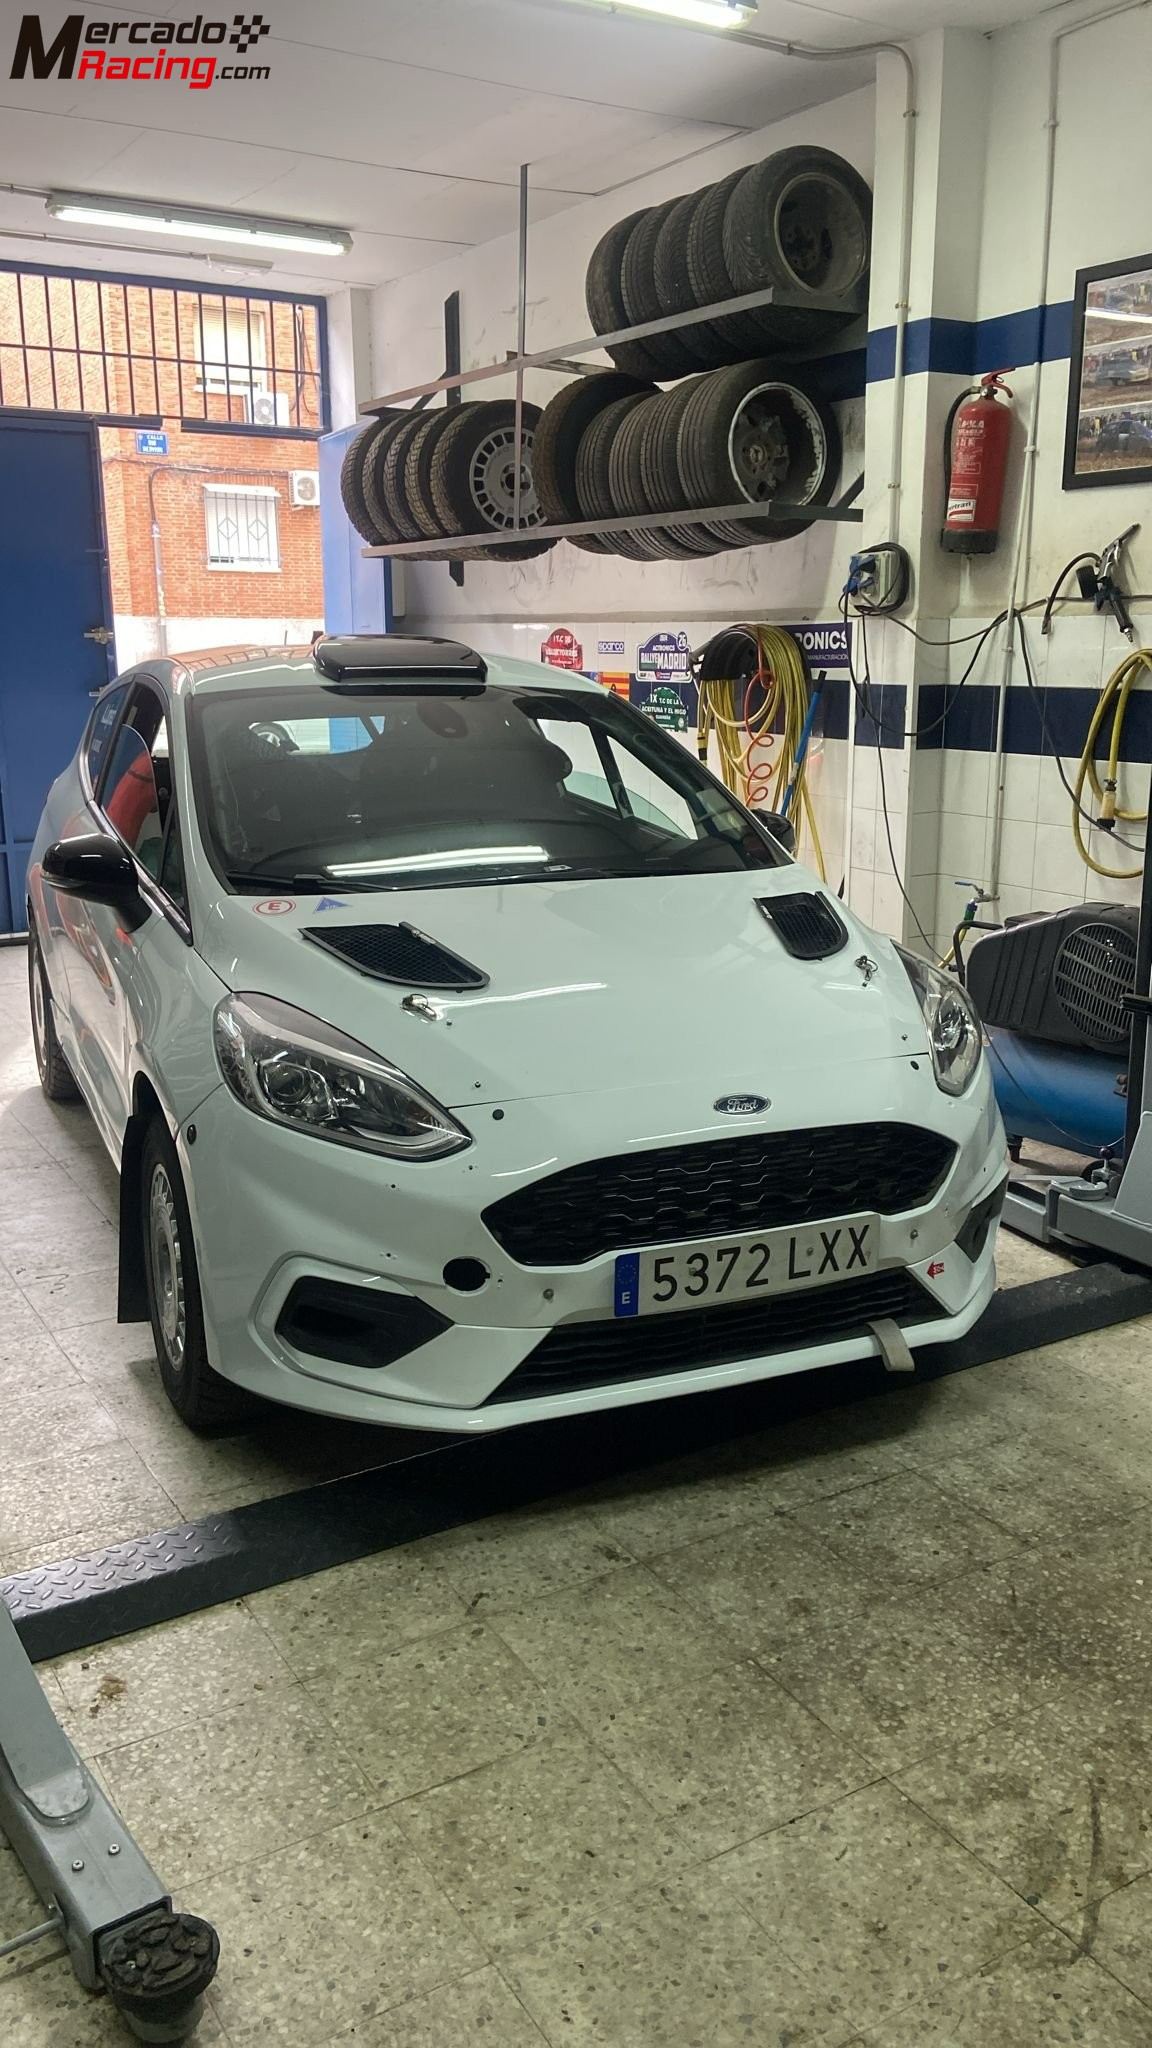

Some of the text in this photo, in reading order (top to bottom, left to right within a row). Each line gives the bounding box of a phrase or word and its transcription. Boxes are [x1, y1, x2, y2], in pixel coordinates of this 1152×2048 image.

[598, 641, 625, 652] sparco
[678, 634, 686, 647] 26
[640, 652, 687, 670] RALLYE MADRID
[650, 693, 658, 704] IX
[641, 705, 664, 713] ACEITUNA
[268, 902, 282, 911] E
[727, 1097, 759, 1112] Ford
[652, 1224, 870, 1302] 5372 LXX
[621, 1291, 631, 1305] E
